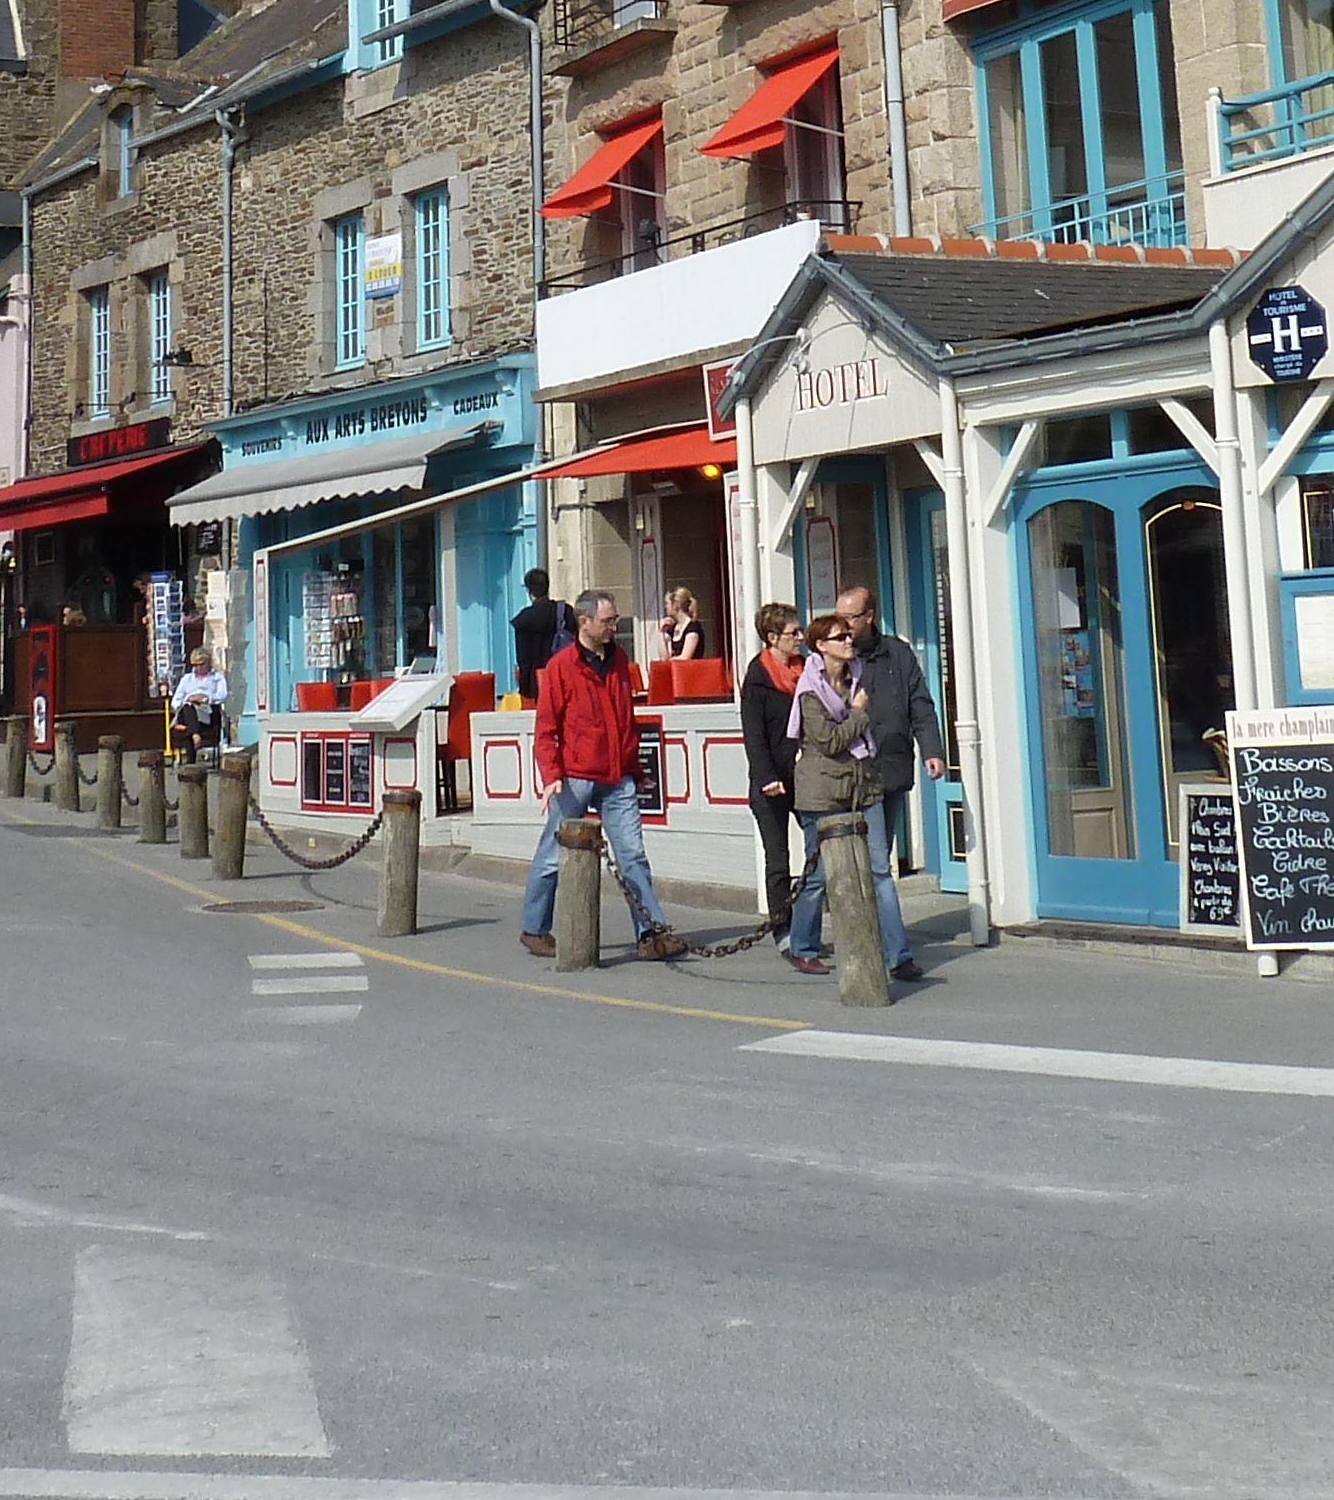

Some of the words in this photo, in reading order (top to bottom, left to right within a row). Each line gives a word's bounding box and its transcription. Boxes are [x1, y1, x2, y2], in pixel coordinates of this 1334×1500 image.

[1263, 303, 1307, 317] TOURISME
[1271, 315, 1303, 353] H
[796, 357, 889, 413] HOTEL
[242, 436, 283, 457] SOUVENIRS
[306, 418, 330, 445] AUX
[334, 407, 366, 439] ARTS
[370, 398, 427, 432] BRETONS
[453, 391, 500, 416] CADEAUX
[1232, 716, 1244, 739] la
[1240, 748, 1334, 776] Boissons
[1257, 801, 1330, 825] Bières
[1272, 850, 1327, 875] Cidre
[1250, 875, 1296, 906] Café
[1256, 910, 1292, 937] Vin
